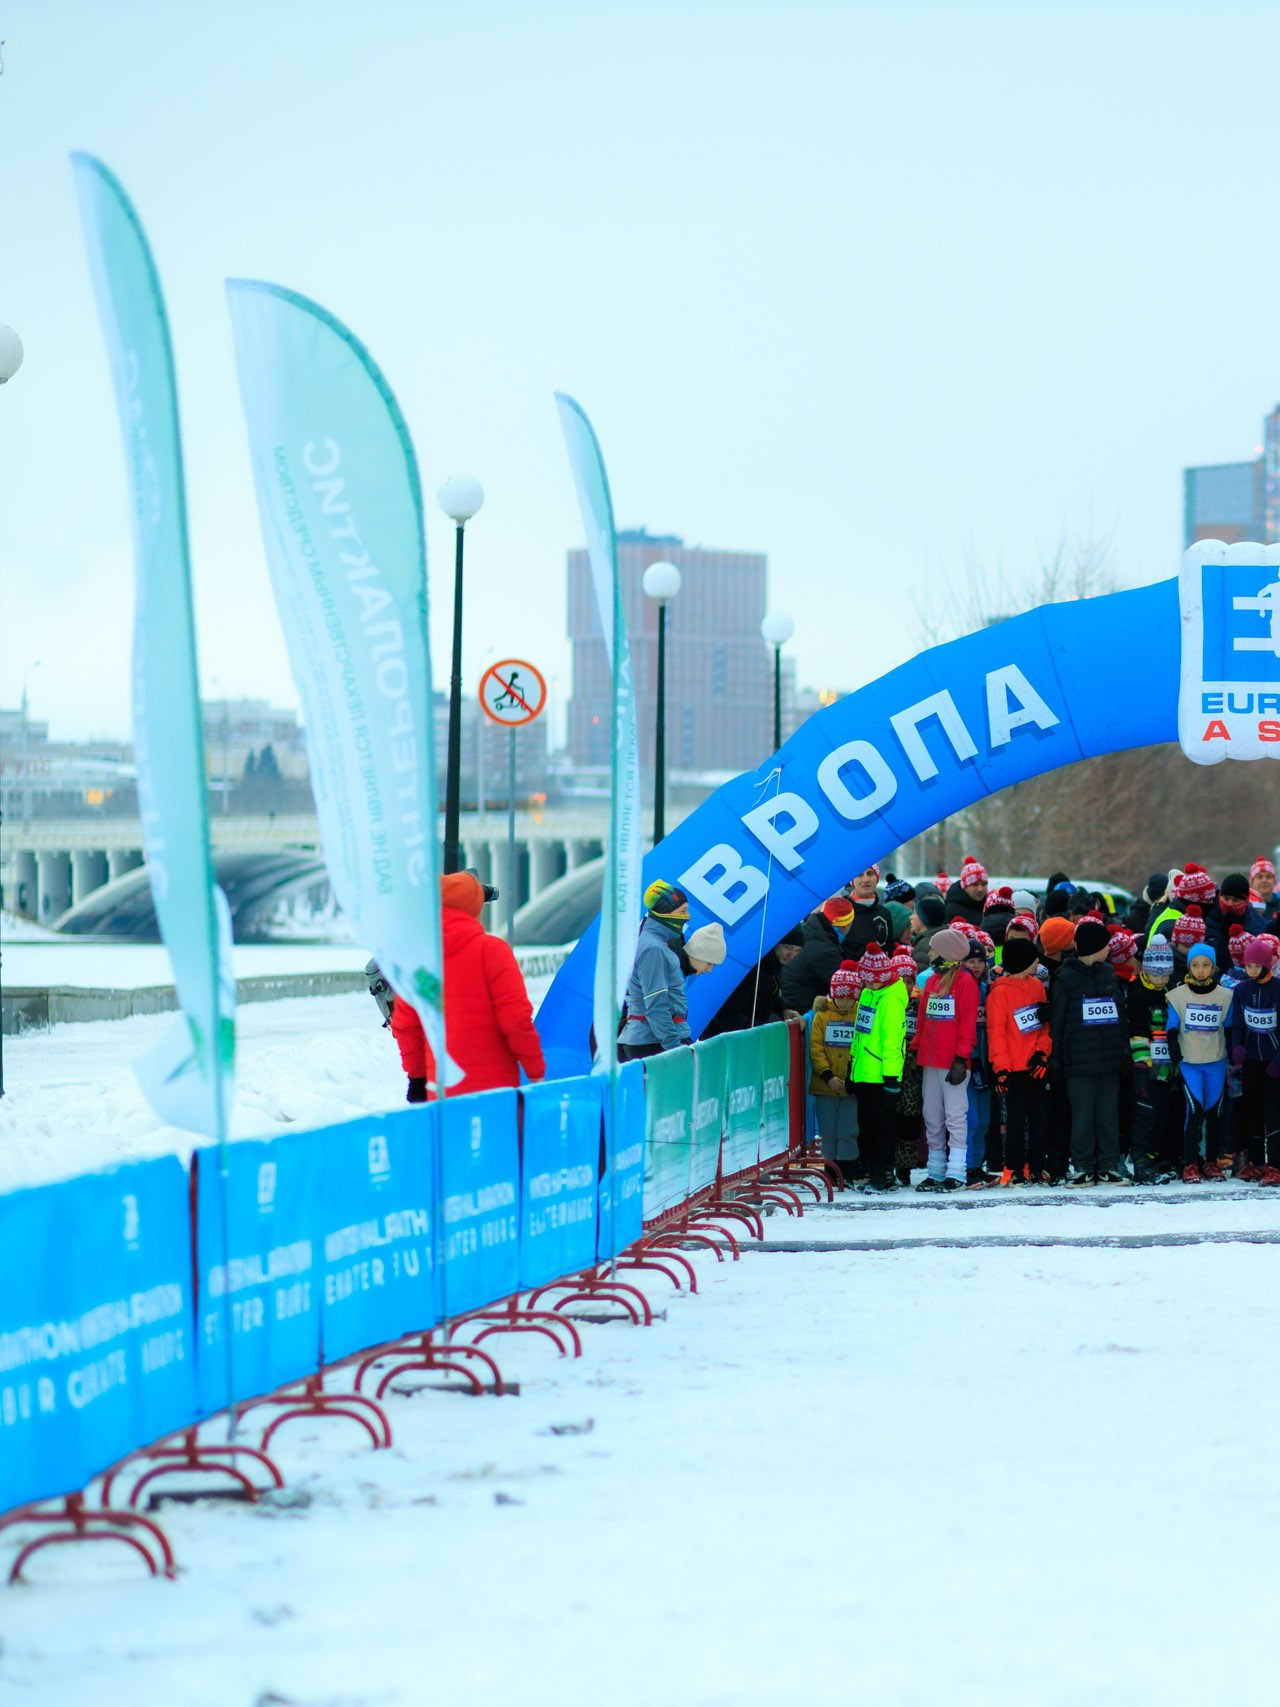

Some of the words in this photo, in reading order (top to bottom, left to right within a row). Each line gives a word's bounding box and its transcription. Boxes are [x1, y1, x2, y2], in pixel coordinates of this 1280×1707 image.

[677, 663, 1060, 930] ВРОПА
[928, 1002, 950, 1012] 5098
[1088, 1006, 1114, 1016] 5063
[857, 1013, 871, 1024] 045
[1190, 1012, 1218, 1023] 5066
[1247, 1014, 1273, 1025] 5083
